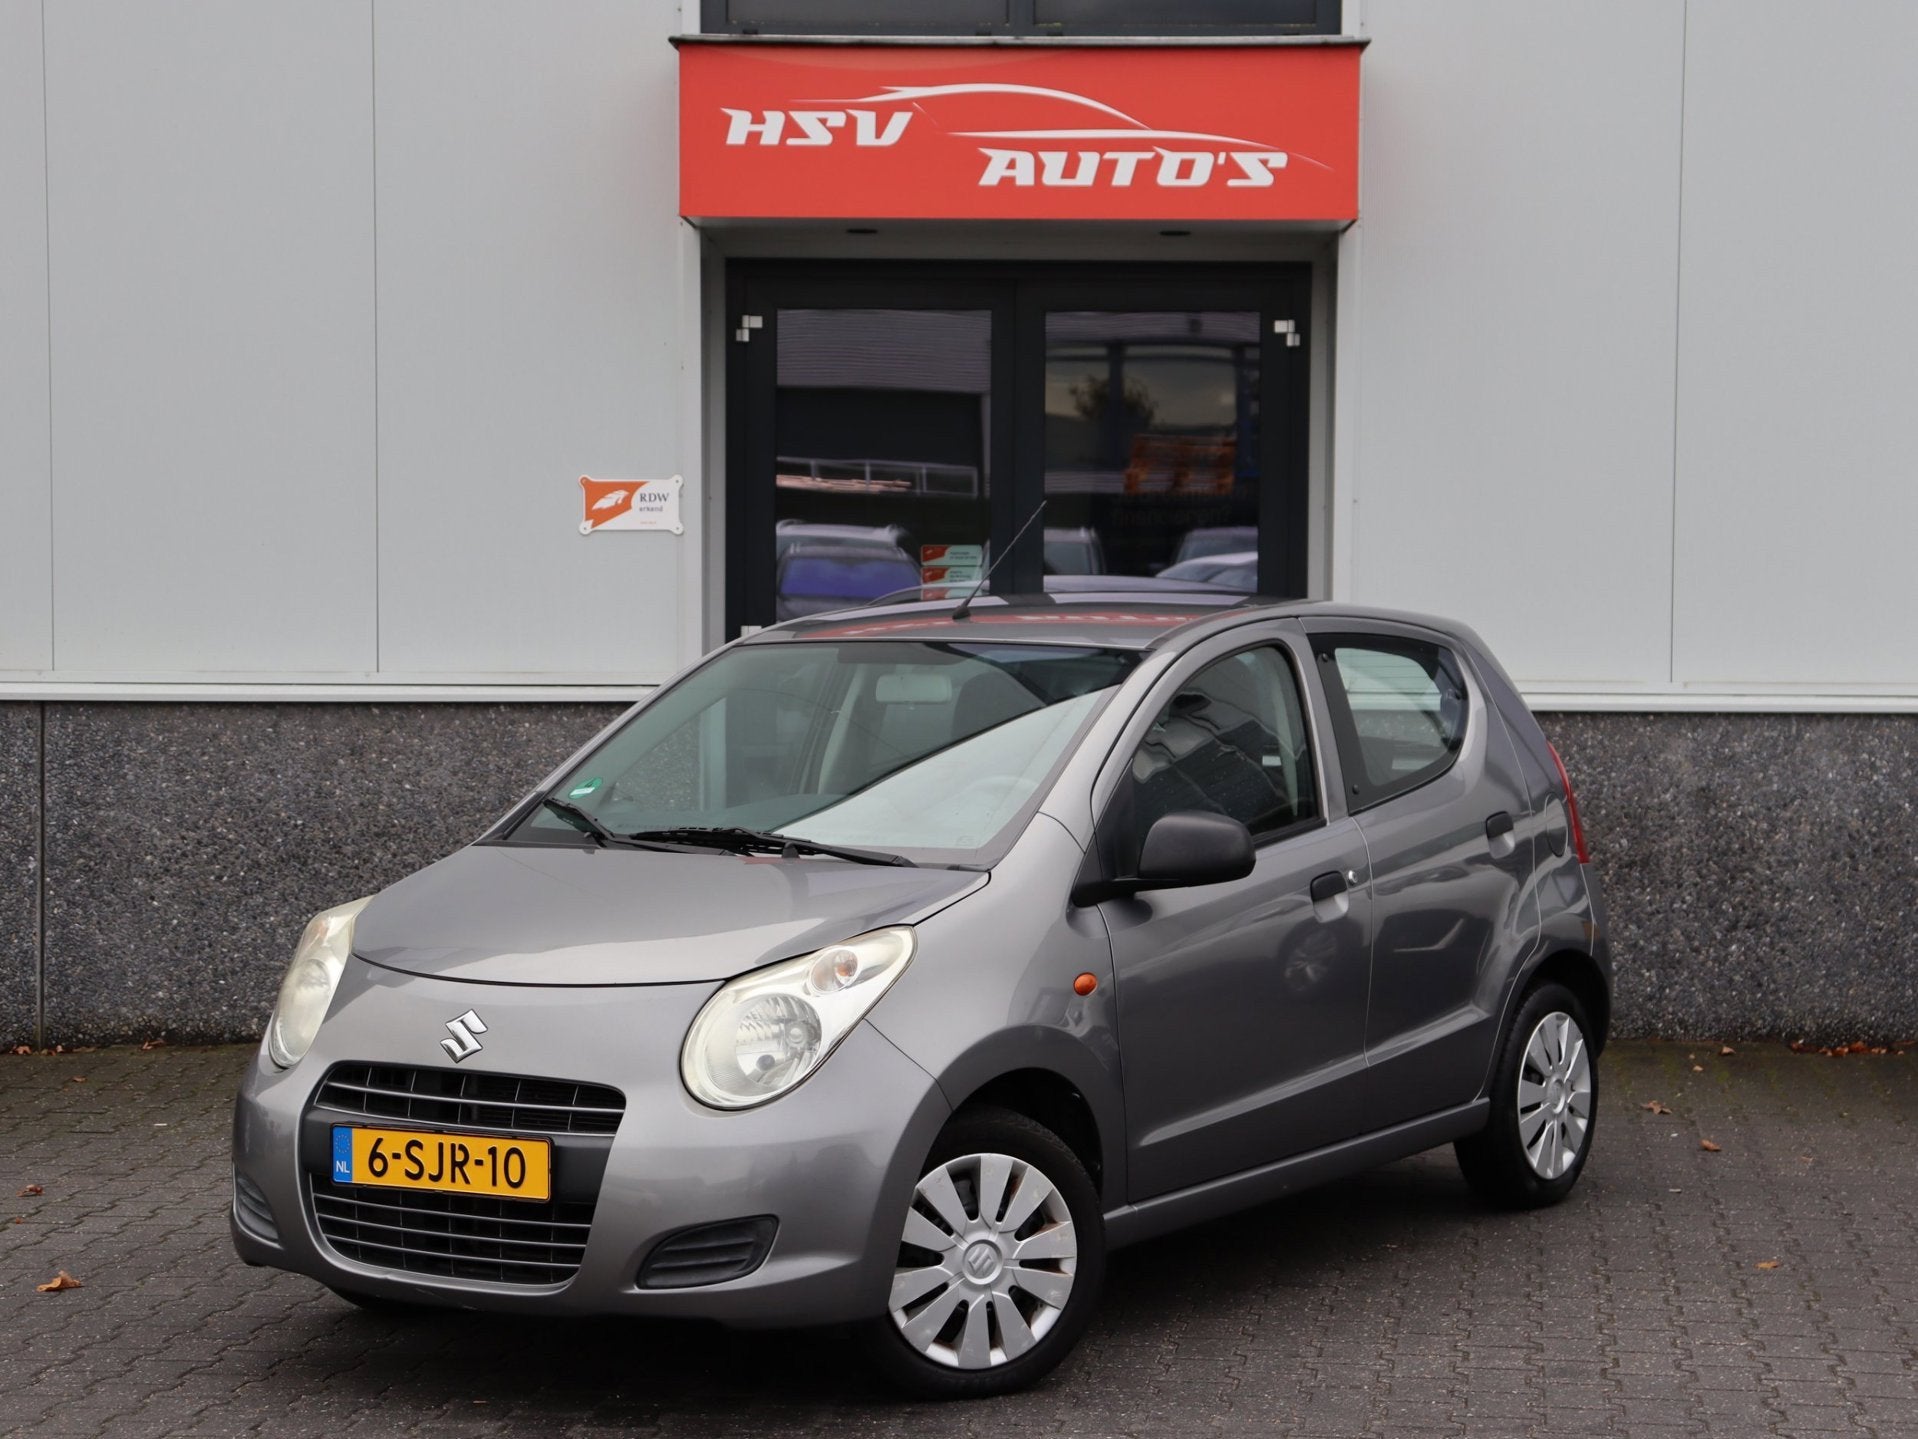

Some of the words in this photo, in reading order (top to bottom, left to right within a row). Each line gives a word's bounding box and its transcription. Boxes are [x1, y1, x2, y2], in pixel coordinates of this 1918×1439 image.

[720, 107, 913, 147] HSV
[977, 146, 1288, 188] AUTO'S
[640, 492, 670, 503] RDW
[336, 1160, 350, 1174] NL
[368, 1137, 527, 1189] 6-SJR-10
